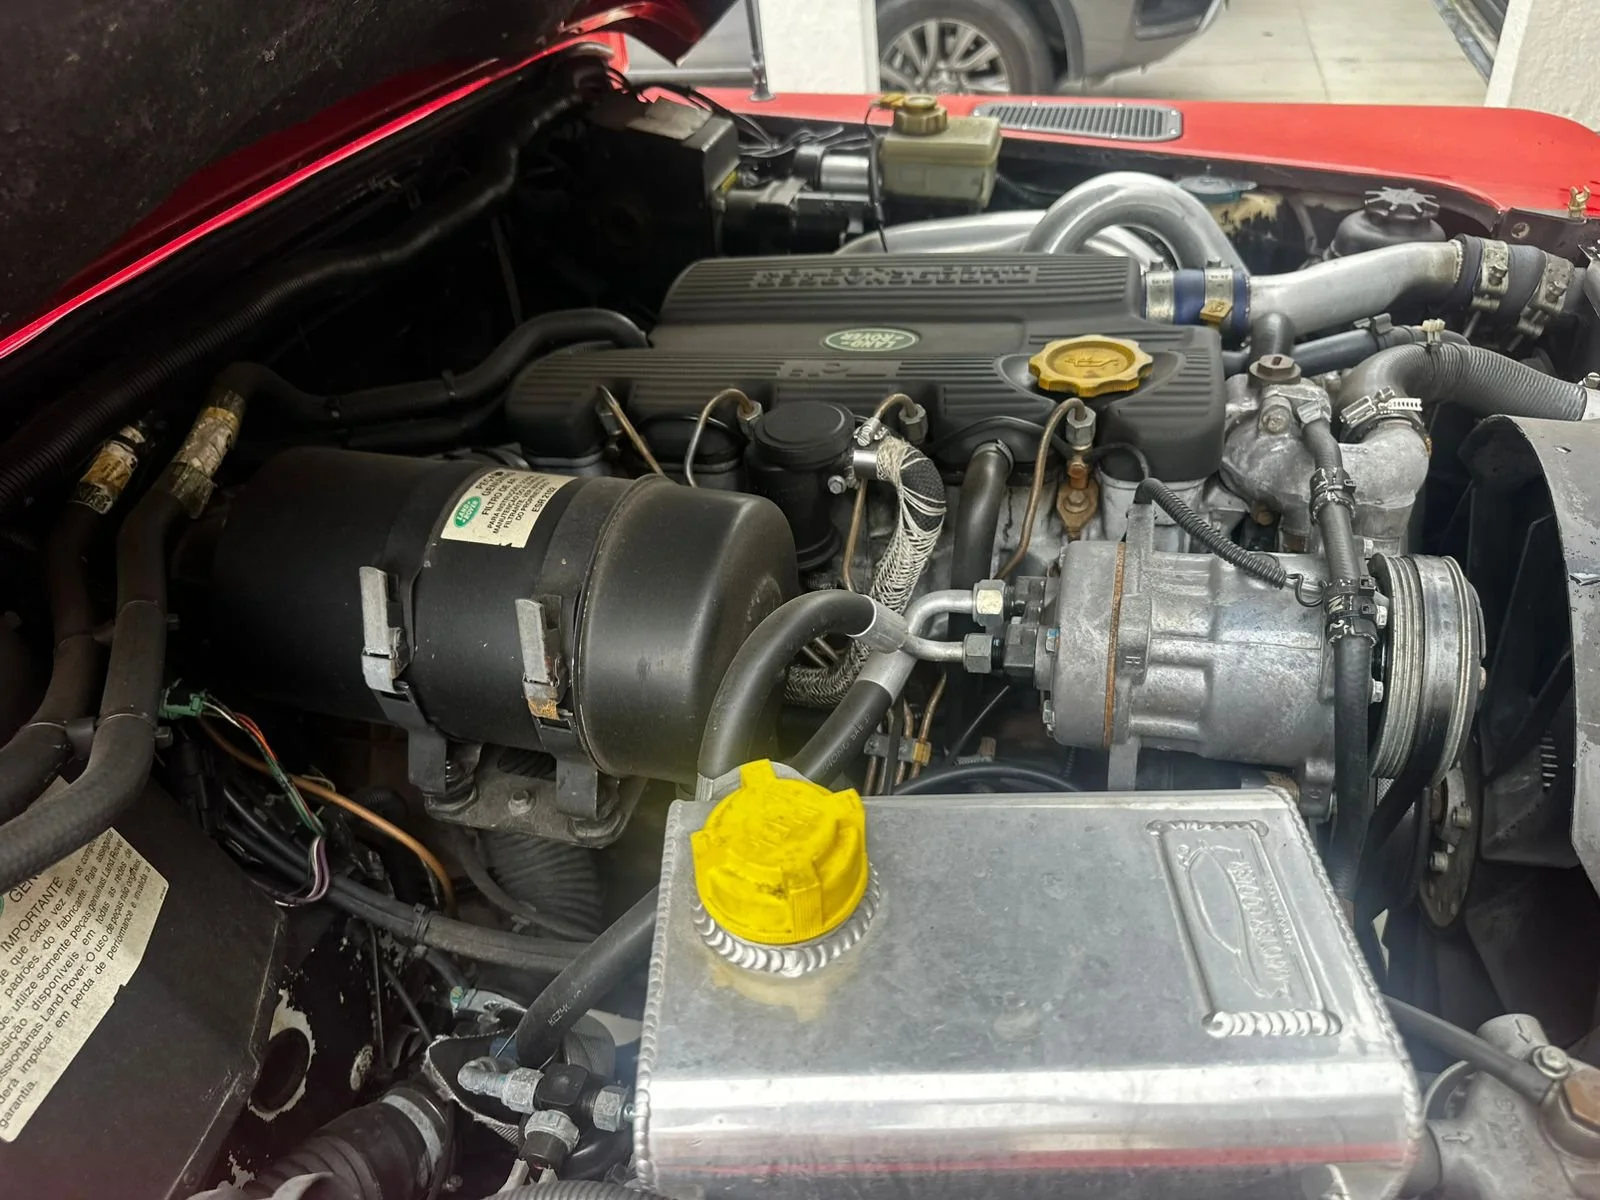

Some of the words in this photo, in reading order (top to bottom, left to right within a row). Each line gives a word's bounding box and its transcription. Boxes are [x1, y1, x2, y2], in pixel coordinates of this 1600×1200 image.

[482, 491, 503, 516] FILTRO
[488, 514, 500, 528] PARA
[493, 495, 520, 533] MANUTENÇÃO
[516, 512, 524, 520] DO
[532, 499, 546, 512] ESR
[10, 945, 29, 966] que
[30, 918, 51, 943] cada
[50, 897, 66, 914] vez
[64, 876, 78, 897] mais
[12, 981, 38, 1012] utilize
[37, 938, 71, 980] somente
[70, 910, 92, 940] peças
[102, 858, 115, 878] Land
[43, 936, 56, 950] do
[85, 866, 98, 884] Para
[32, 951, 79, 1011] disponíveis
[82, 929, 96, 946] em
[95, 901, 111, 924] todas
[108, 886, 117, 898] as
[40, 994, 64, 1022] Land
[86, 951, 96, 963] O
[94, 934, 110, 953] uso
[105, 922, 115, 935] de
[112, 900, 124, 925] peças
[121, 886, 131, 901] não
[18, 1031, 54, 1074] implicar
[55, 1010, 71, 1028] em
[71, 978, 95, 1009] perda
[93, 961, 107, 976] de
[106, 909, 134, 961] performance
[0, 1080, 38, 1130] garantia.
